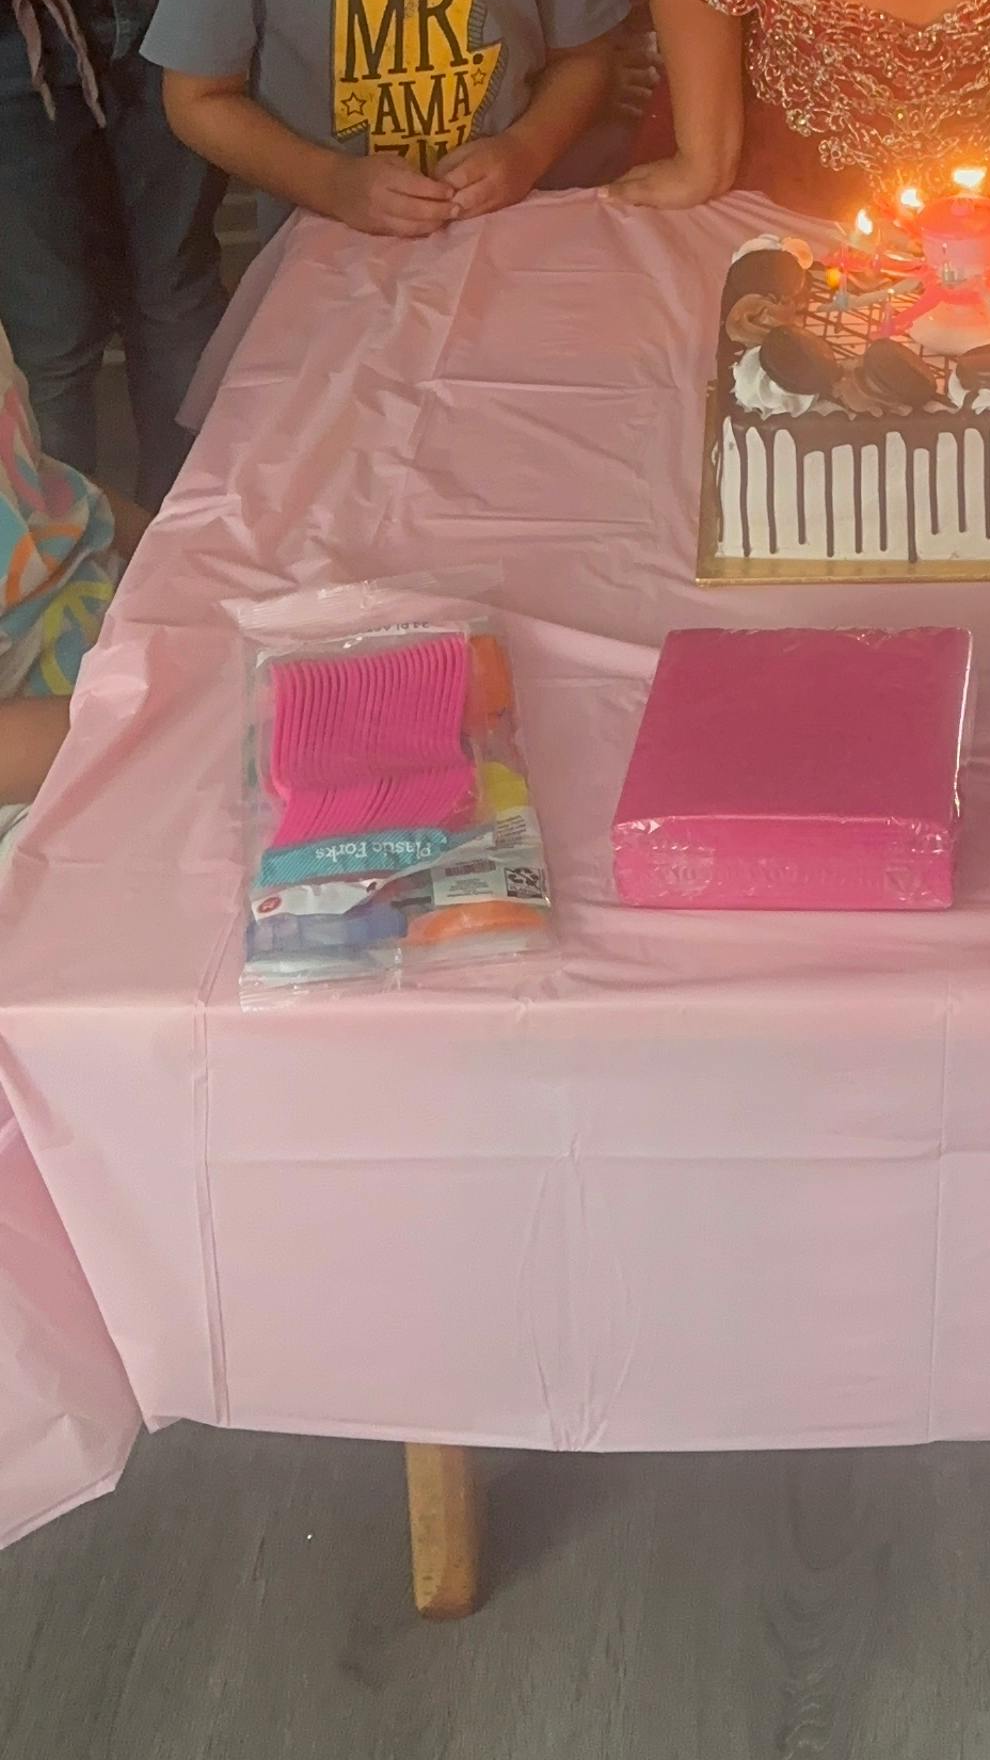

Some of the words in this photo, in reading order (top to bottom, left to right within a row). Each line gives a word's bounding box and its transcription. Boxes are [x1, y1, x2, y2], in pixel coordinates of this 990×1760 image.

[371, 70, 472, 139] AMA
[314, 841, 368, 862] Forks
[372, 840, 432, 860] Plastic
